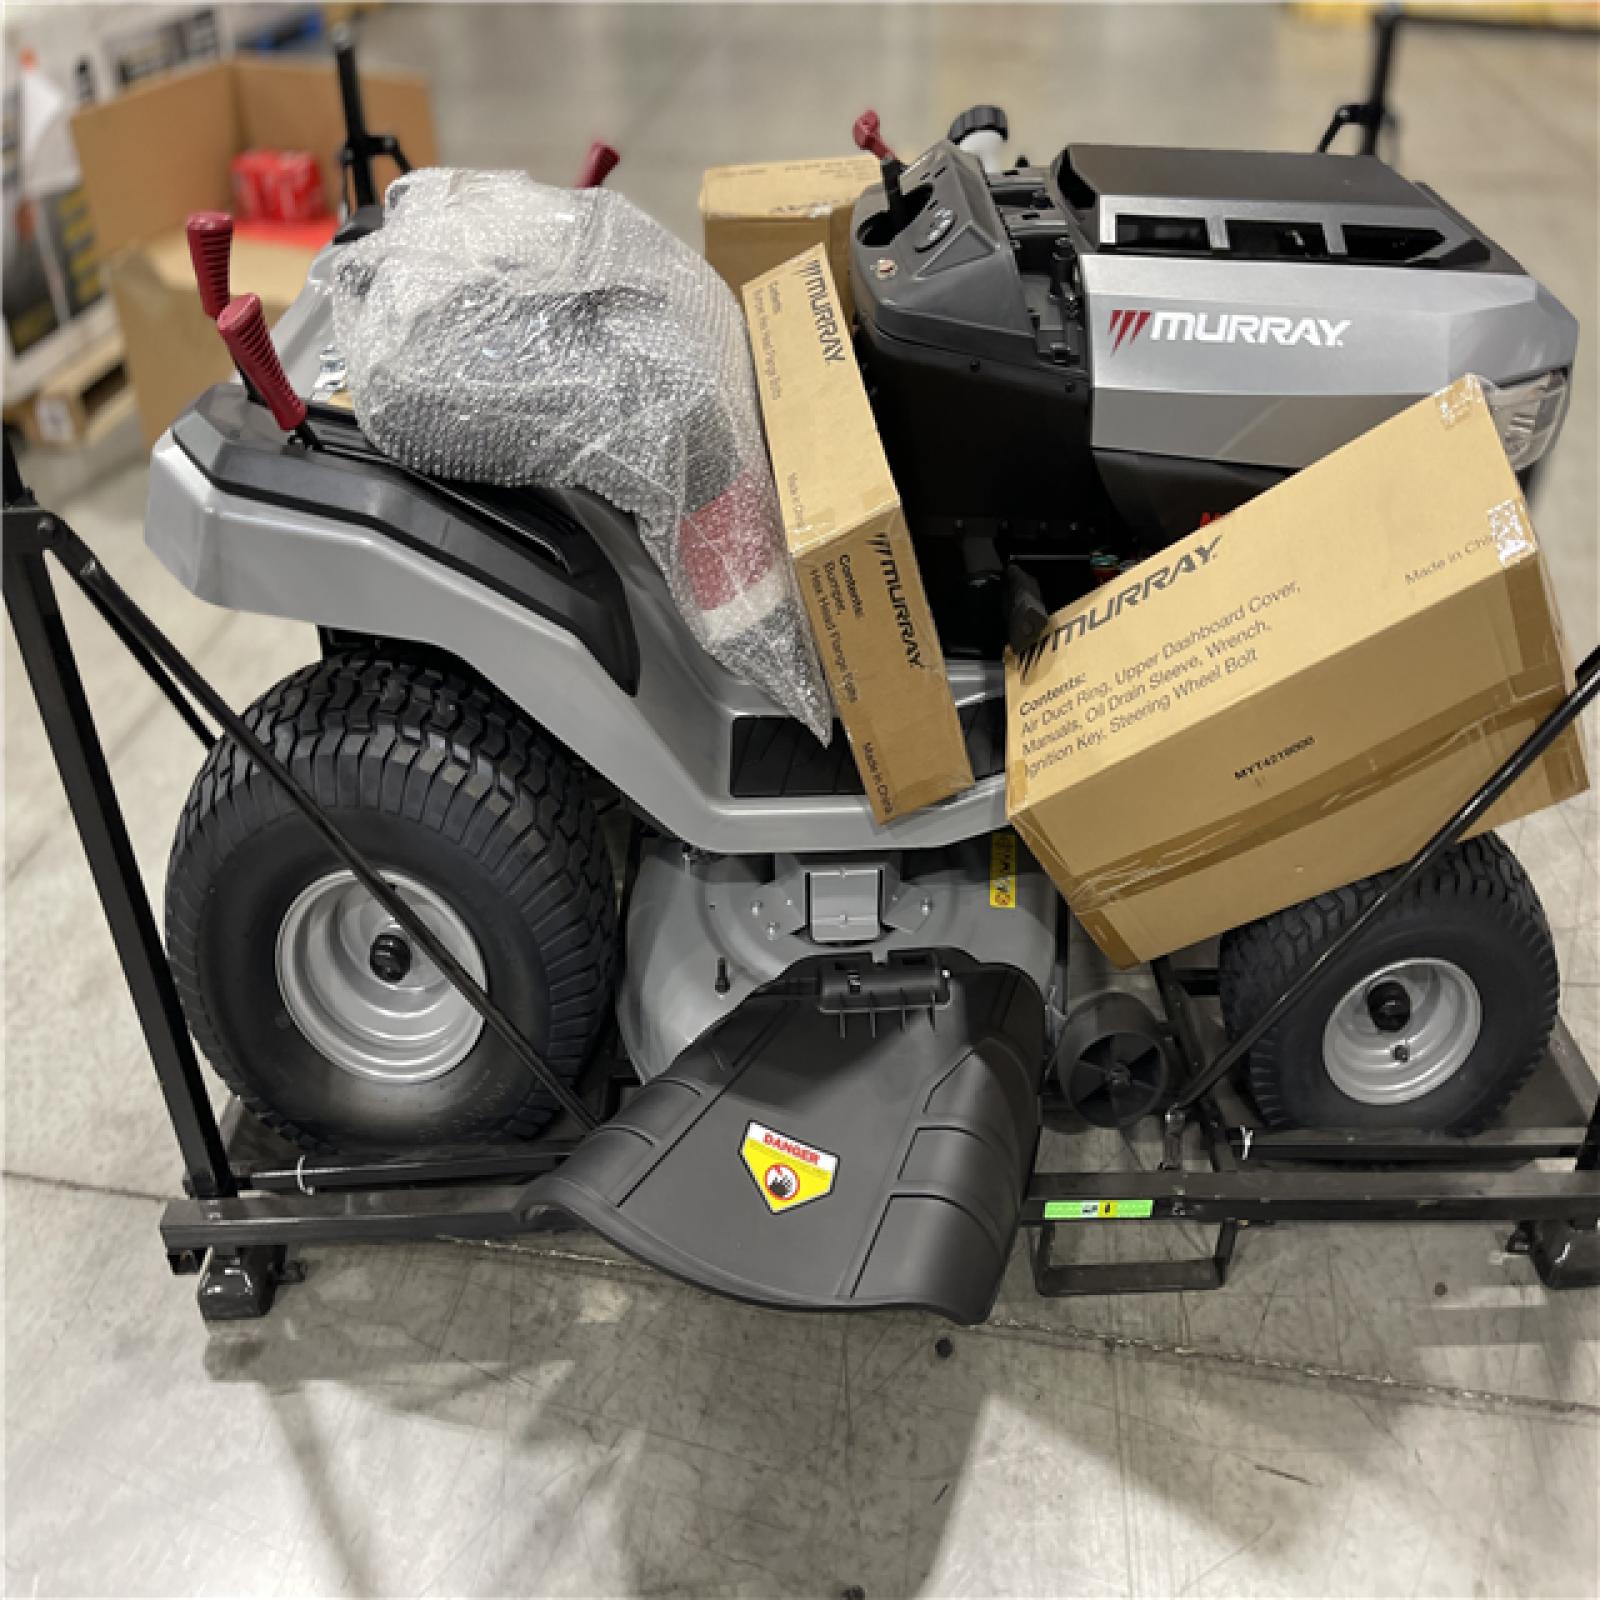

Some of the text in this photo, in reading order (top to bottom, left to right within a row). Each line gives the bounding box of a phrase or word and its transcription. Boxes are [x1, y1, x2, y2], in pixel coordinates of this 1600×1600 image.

[804, 274, 846, 364] MURRAY
[1151, 311, 1352, 347] MURRAY
[879, 558, 926, 669] MURRAY
[1052, 534, 1222, 653] MURRAY
[1404, 558, 1446, 586] Made
[1020, 672, 1086, 716] Contents:
[1022, 719, 1038, 738] Air
[1042, 699, 1073, 726] Duct
[1114, 652, 1160, 686] Upper
[1162, 604, 1246, 660] Dashboard
[1249, 580, 1301, 613] Cover,
[1022, 619, 1271, 756] Manuals, Oil Drain Sleeve, Wrench,
[1024, 744, 1073, 778] Ignition
[1109, 695, 1171, 733] Steering
[1172, 664, 1221, 699] Wheel
[1225, 647, 1258, 675] Bolt
[764, 1133, 821, 1165] DANGER
